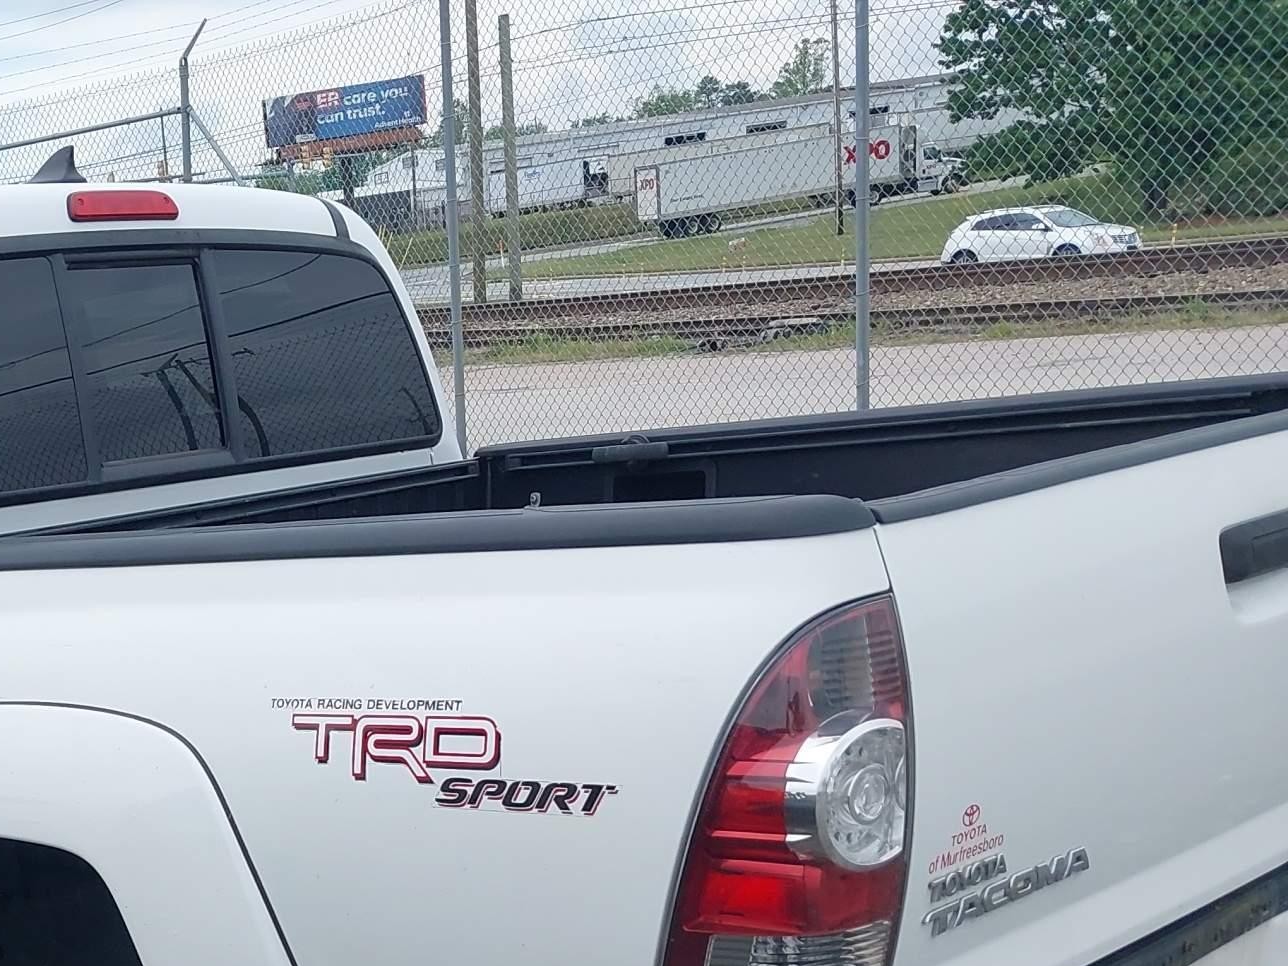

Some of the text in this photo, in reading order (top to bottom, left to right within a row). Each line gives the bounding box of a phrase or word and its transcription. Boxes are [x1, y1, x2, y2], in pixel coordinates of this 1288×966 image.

[316, 86, 409, 108] ER care you
[316, 103, 386, 125] can trust.
[639, 178, 655, 191] XPO
[271, 698, 463, 712] TOYOTA RACING DEVELOPMENT
[292, 714, 501, 784] TRD
[435, 777, 620, 816] SPORT
[951, 824, 987, 847] TOYOTA
[928, 833, 1005, 875] of Murfreesboro
[921, 846, 1090, 938] TACOMA
[927, 853, 1008, 903] TOYOTA
